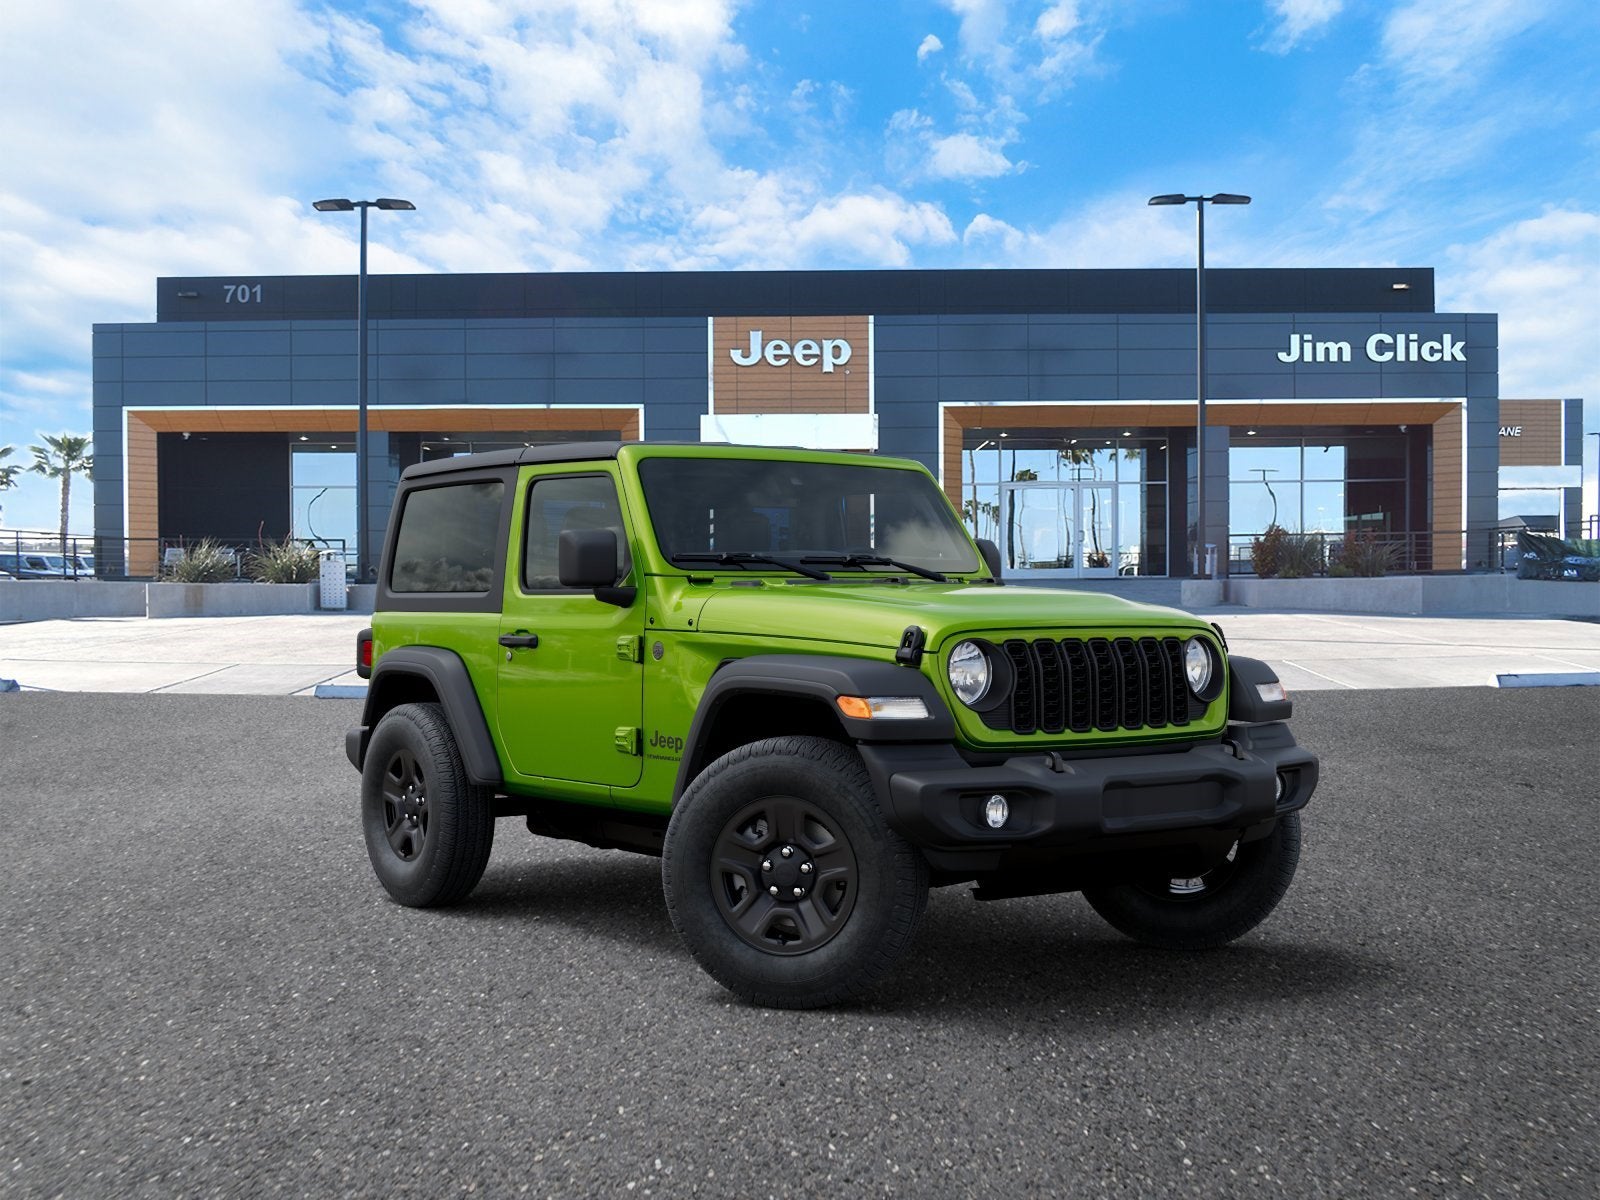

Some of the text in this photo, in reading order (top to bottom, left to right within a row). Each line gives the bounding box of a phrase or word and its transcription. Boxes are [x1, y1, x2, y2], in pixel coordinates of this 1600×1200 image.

[223, 284, 262, 303] 701
[729, 329, 852, 374] Jeep
[1277, 332, 1467, 363] Jim Click
[649, 729, 683, 754] Jeep
